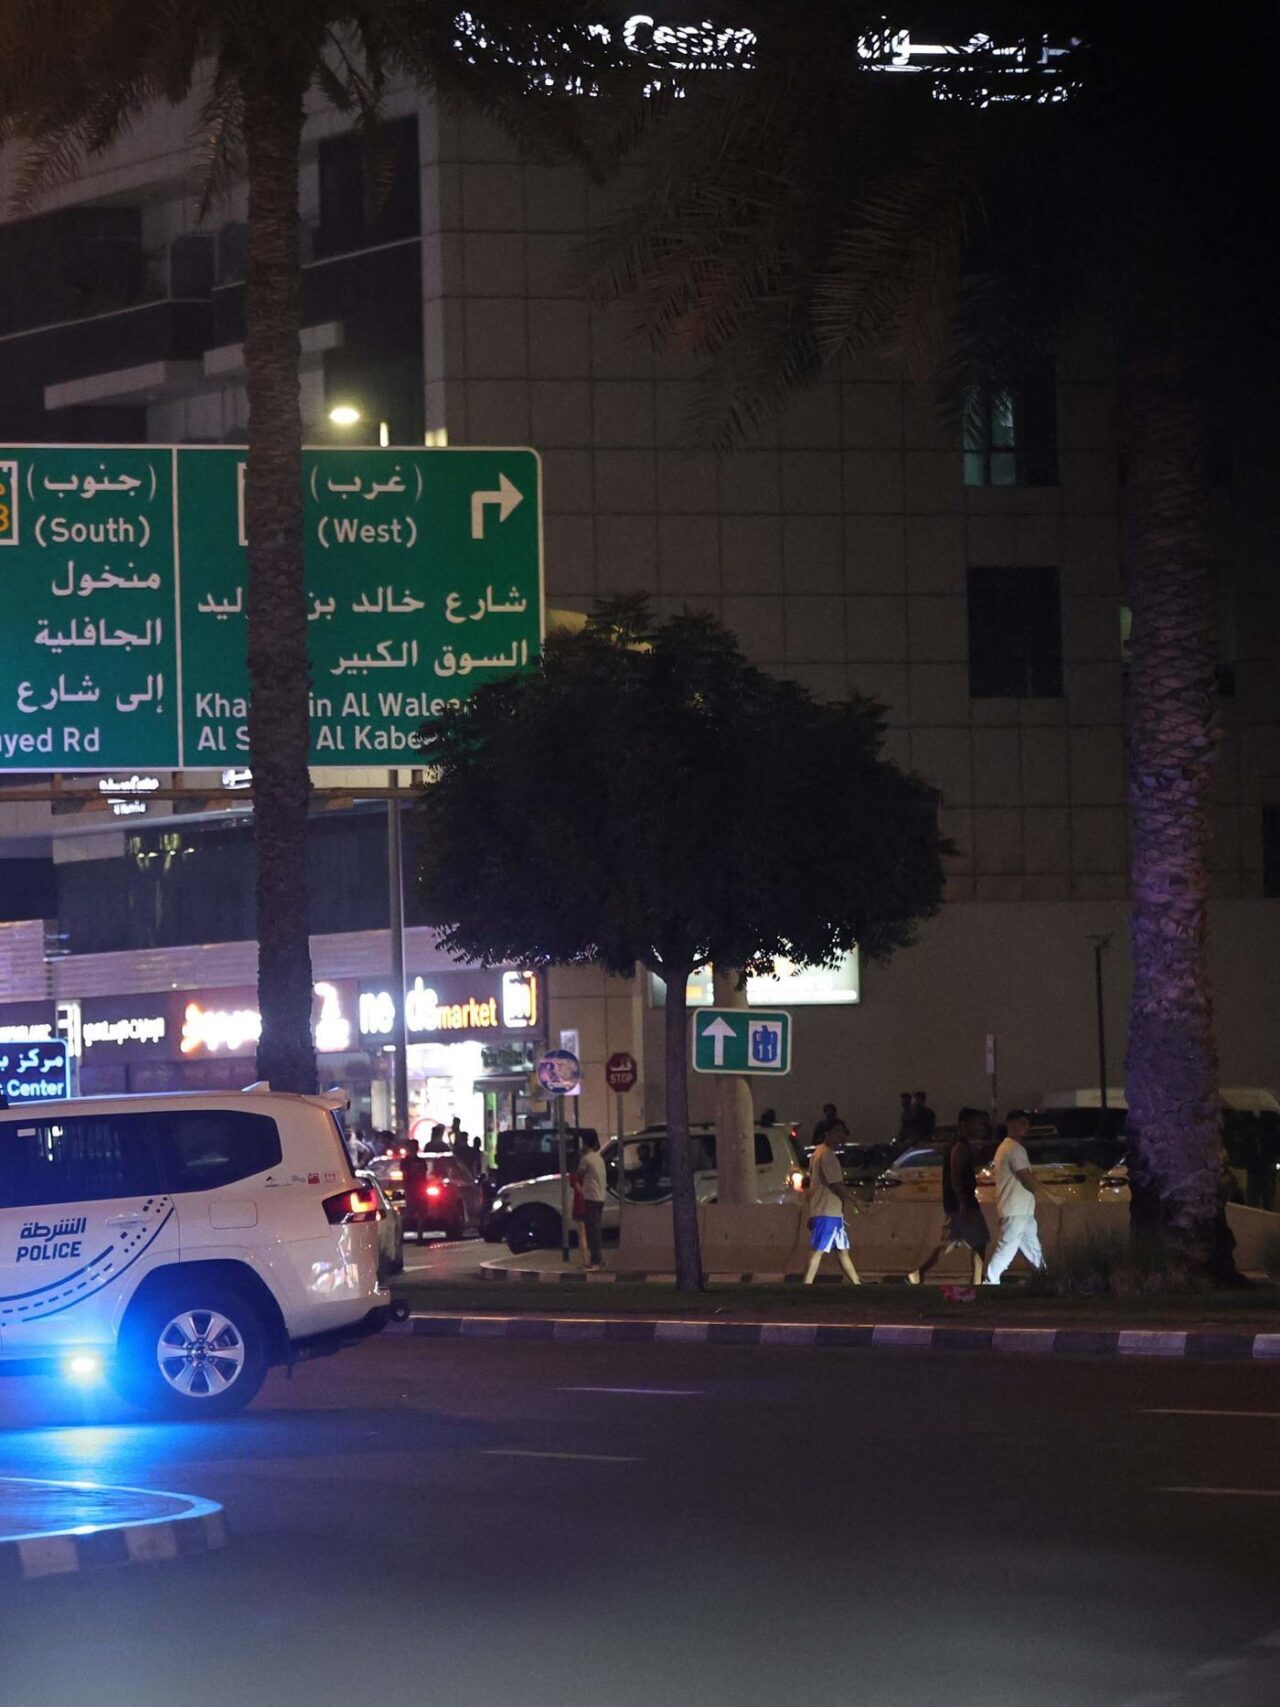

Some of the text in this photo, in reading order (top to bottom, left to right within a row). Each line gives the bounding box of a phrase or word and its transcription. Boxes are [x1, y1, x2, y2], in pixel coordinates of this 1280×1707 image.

[34, 515, 151, 548] (South)
[317, 516, 418, 549] (West)
[52, 560, 161, 597] منخول
[352, 586, 425, 612] خالد
[445, 586, 526, 624] شارع
[34, 617, 162, 654] الجافلية
[330, 639, 528, 677] السوق الكبير
[17, 674, 100, 713] شارع
[116, 673, 163, 713] إلى
[196, 693, 251, 718] Kha
[308, 691, 332, 717] in
[342, 692, 370, 717] Al
[63, 727, 100, 752] Rd
[197, 726, 227, 751] Al
[316, 725, 345, 750] Al
[355, 725, 424, 750] Kabe
[438, 996, 498, 1030] market
[16, 1048, 64, 1073] مركز
[7, 1079, 65, 1097] Center
[20, 1217, 87, 1242] الشرطة
[16, 1241, 82, 1263] POLICE
